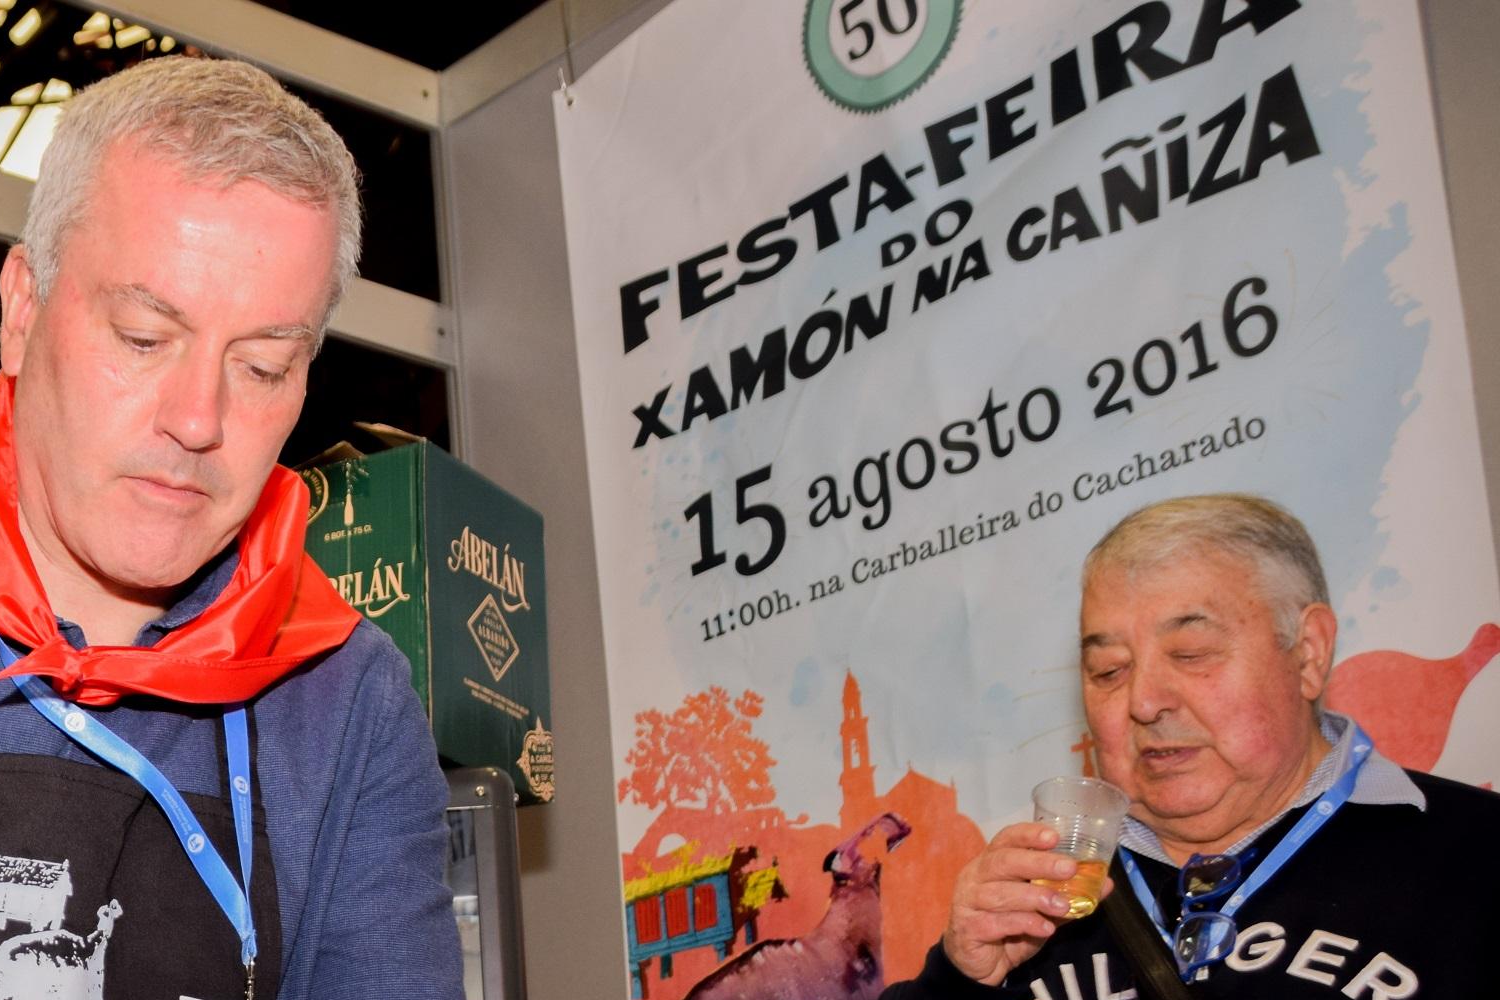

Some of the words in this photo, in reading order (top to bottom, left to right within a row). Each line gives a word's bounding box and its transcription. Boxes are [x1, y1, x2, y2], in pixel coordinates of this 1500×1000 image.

[880, 198, 973, 268] DO
[632, 281, 894, 449] XAMÓN
[912, 238, 991, 314] NA
[683, 462, 787, 577] 15
[808, 387, 1061, 530] agosto
[1087, 277, 1278, 419] 2016
[329, 557, 410, 618] ELÁN
[447, 526, 531, 612] ABELÁN
[701, 589, 800, 642] 11:00h.
[809, 575, 845, 603] na
[851, 507, 1020, 584] Carballeira
[1027, 491, 1063, 521] do
[1073, 416, 1266, 502] Cacharado
